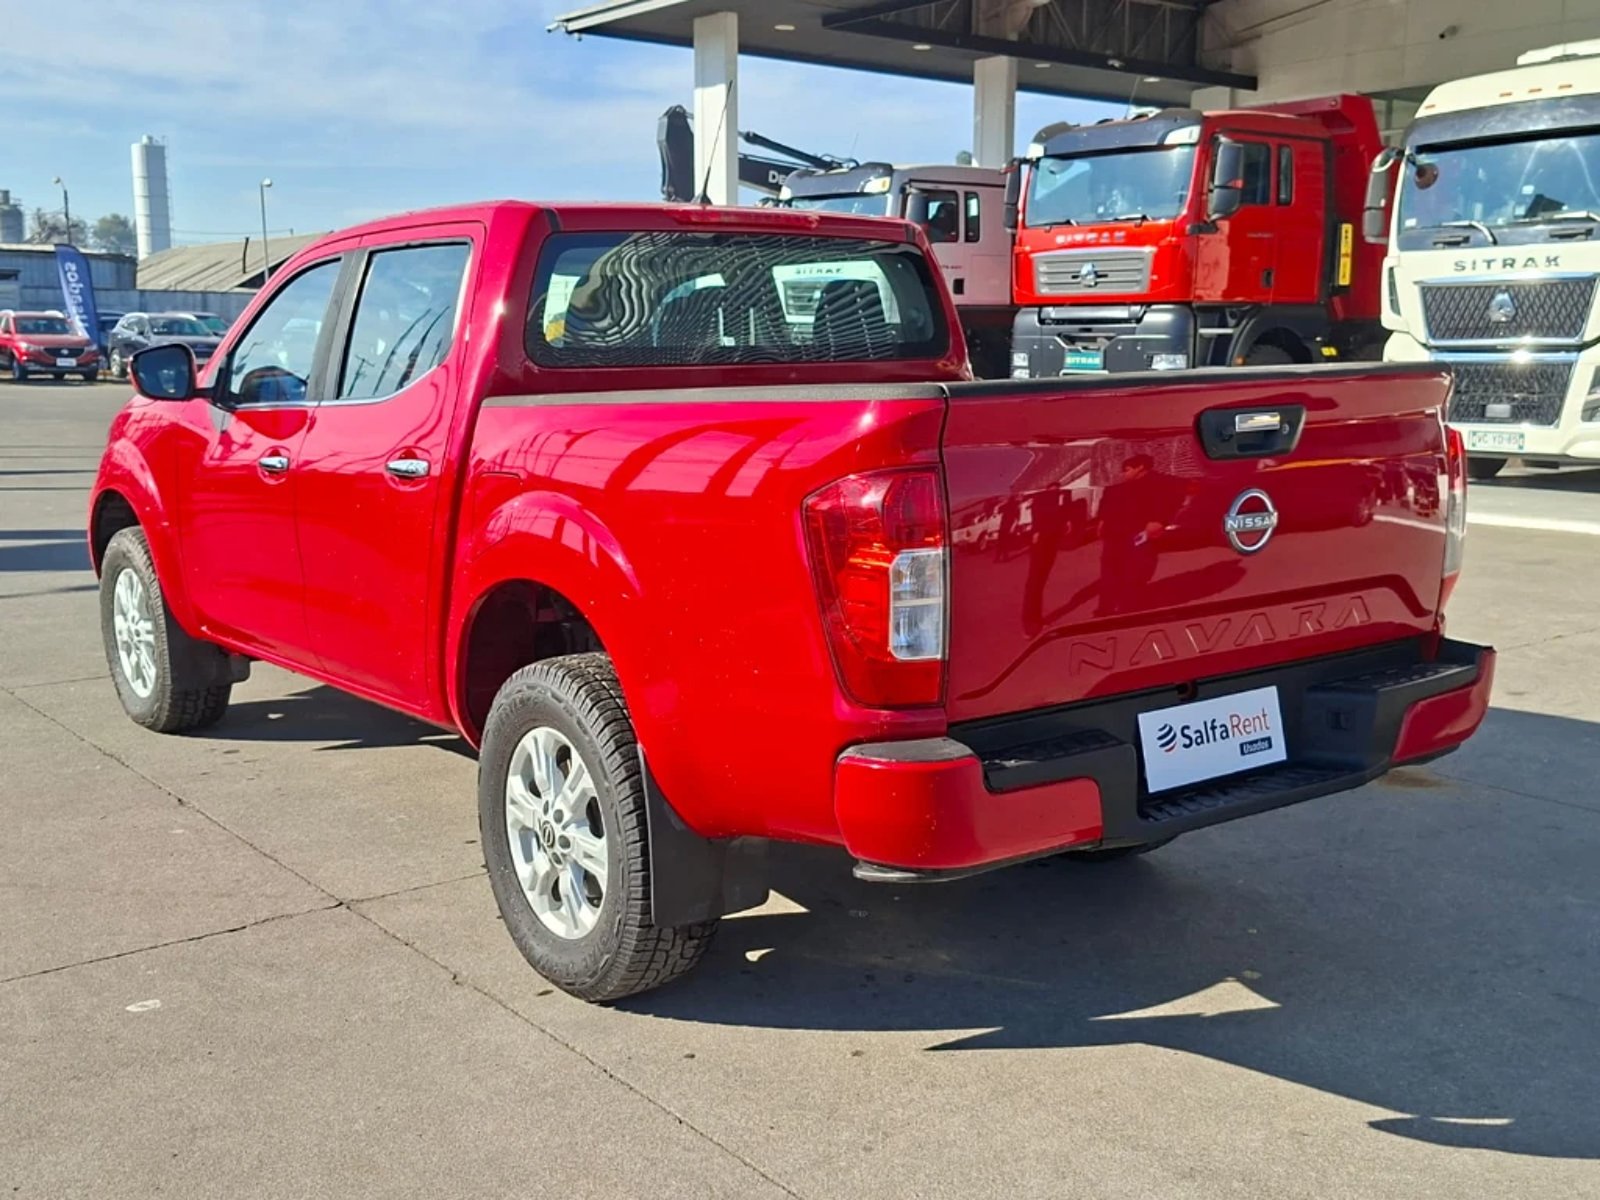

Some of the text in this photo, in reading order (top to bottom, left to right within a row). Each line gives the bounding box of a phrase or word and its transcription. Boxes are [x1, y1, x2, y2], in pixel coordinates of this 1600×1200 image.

[1453, 255, 1561, 272] SITRAK
[1067, 595, 1372, 677] NAVARA
[1180, 707, 1271, 750] SalfaRent
